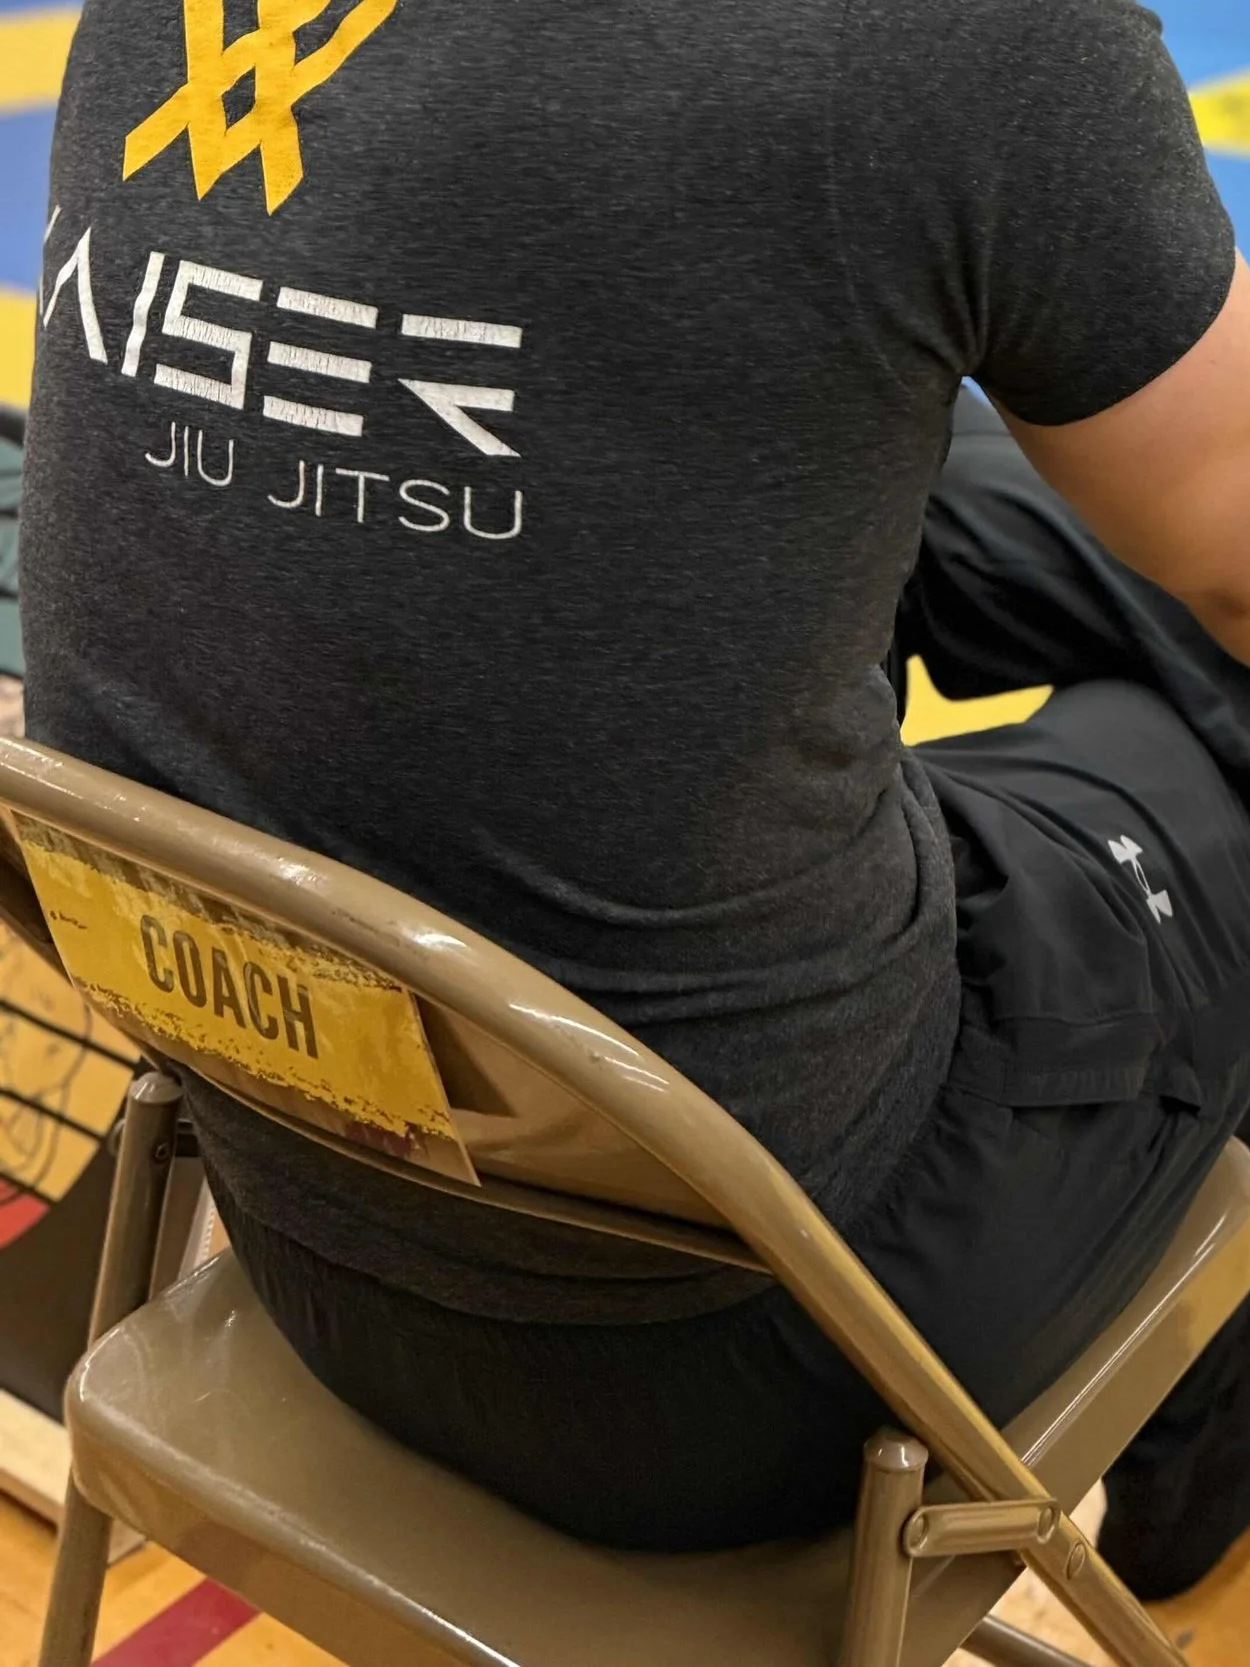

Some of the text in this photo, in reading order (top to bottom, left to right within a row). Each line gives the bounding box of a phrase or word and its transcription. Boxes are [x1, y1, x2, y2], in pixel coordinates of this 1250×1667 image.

[144, 421, 523, 540] JIU JITSU
[140, 914, 319, 1060] COACH
